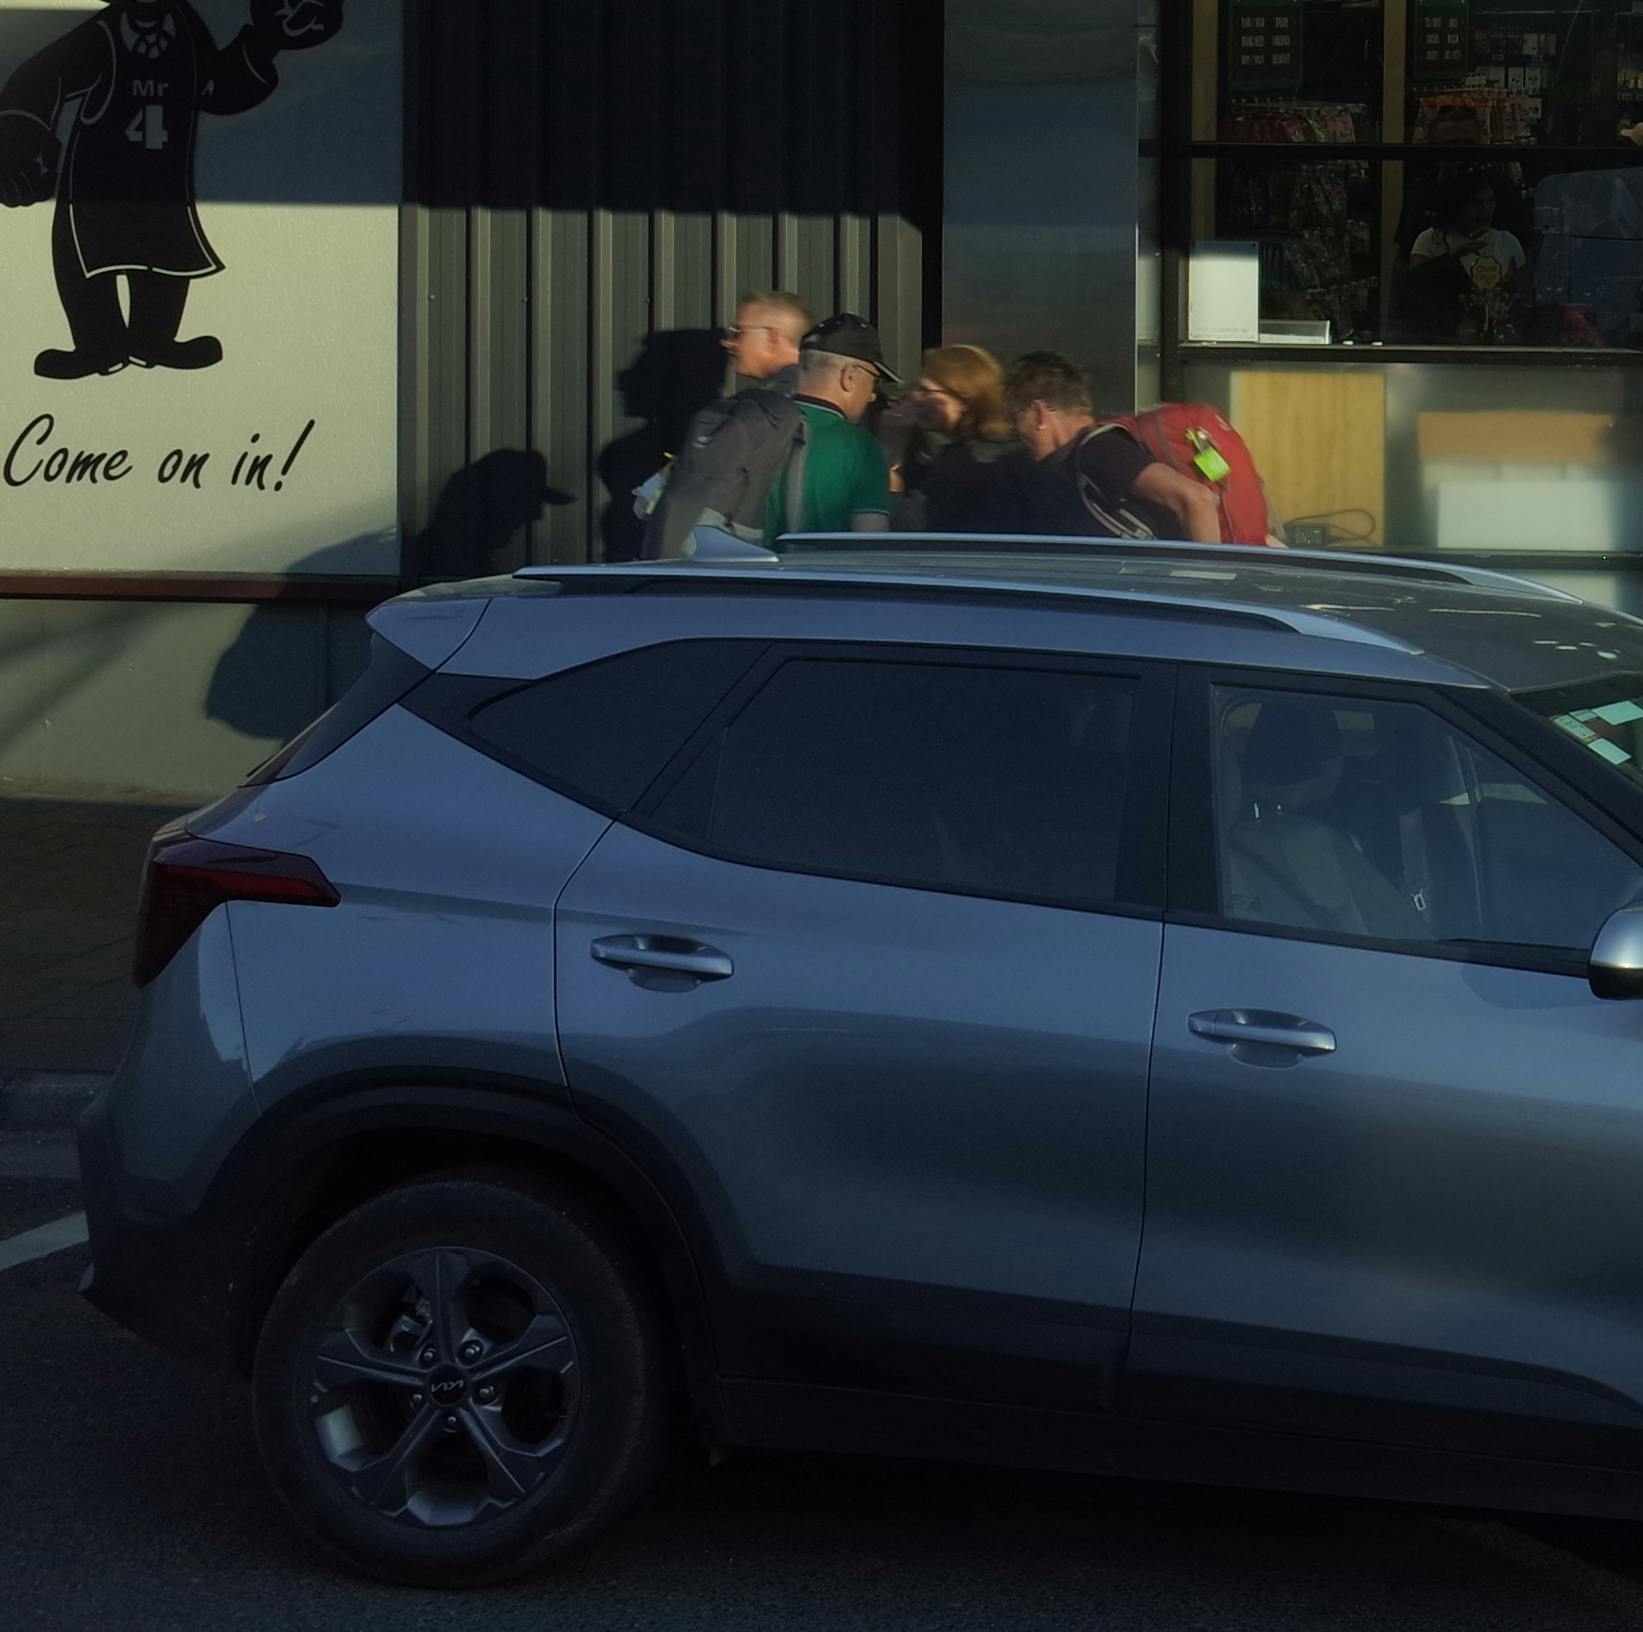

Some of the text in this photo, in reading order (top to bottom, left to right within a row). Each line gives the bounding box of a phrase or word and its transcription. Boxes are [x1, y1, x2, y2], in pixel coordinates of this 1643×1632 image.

[133, 79, 168, 97] Mr
[125, 105, 168, 149] 4
[3, 413, 316, 492] Come on in!
